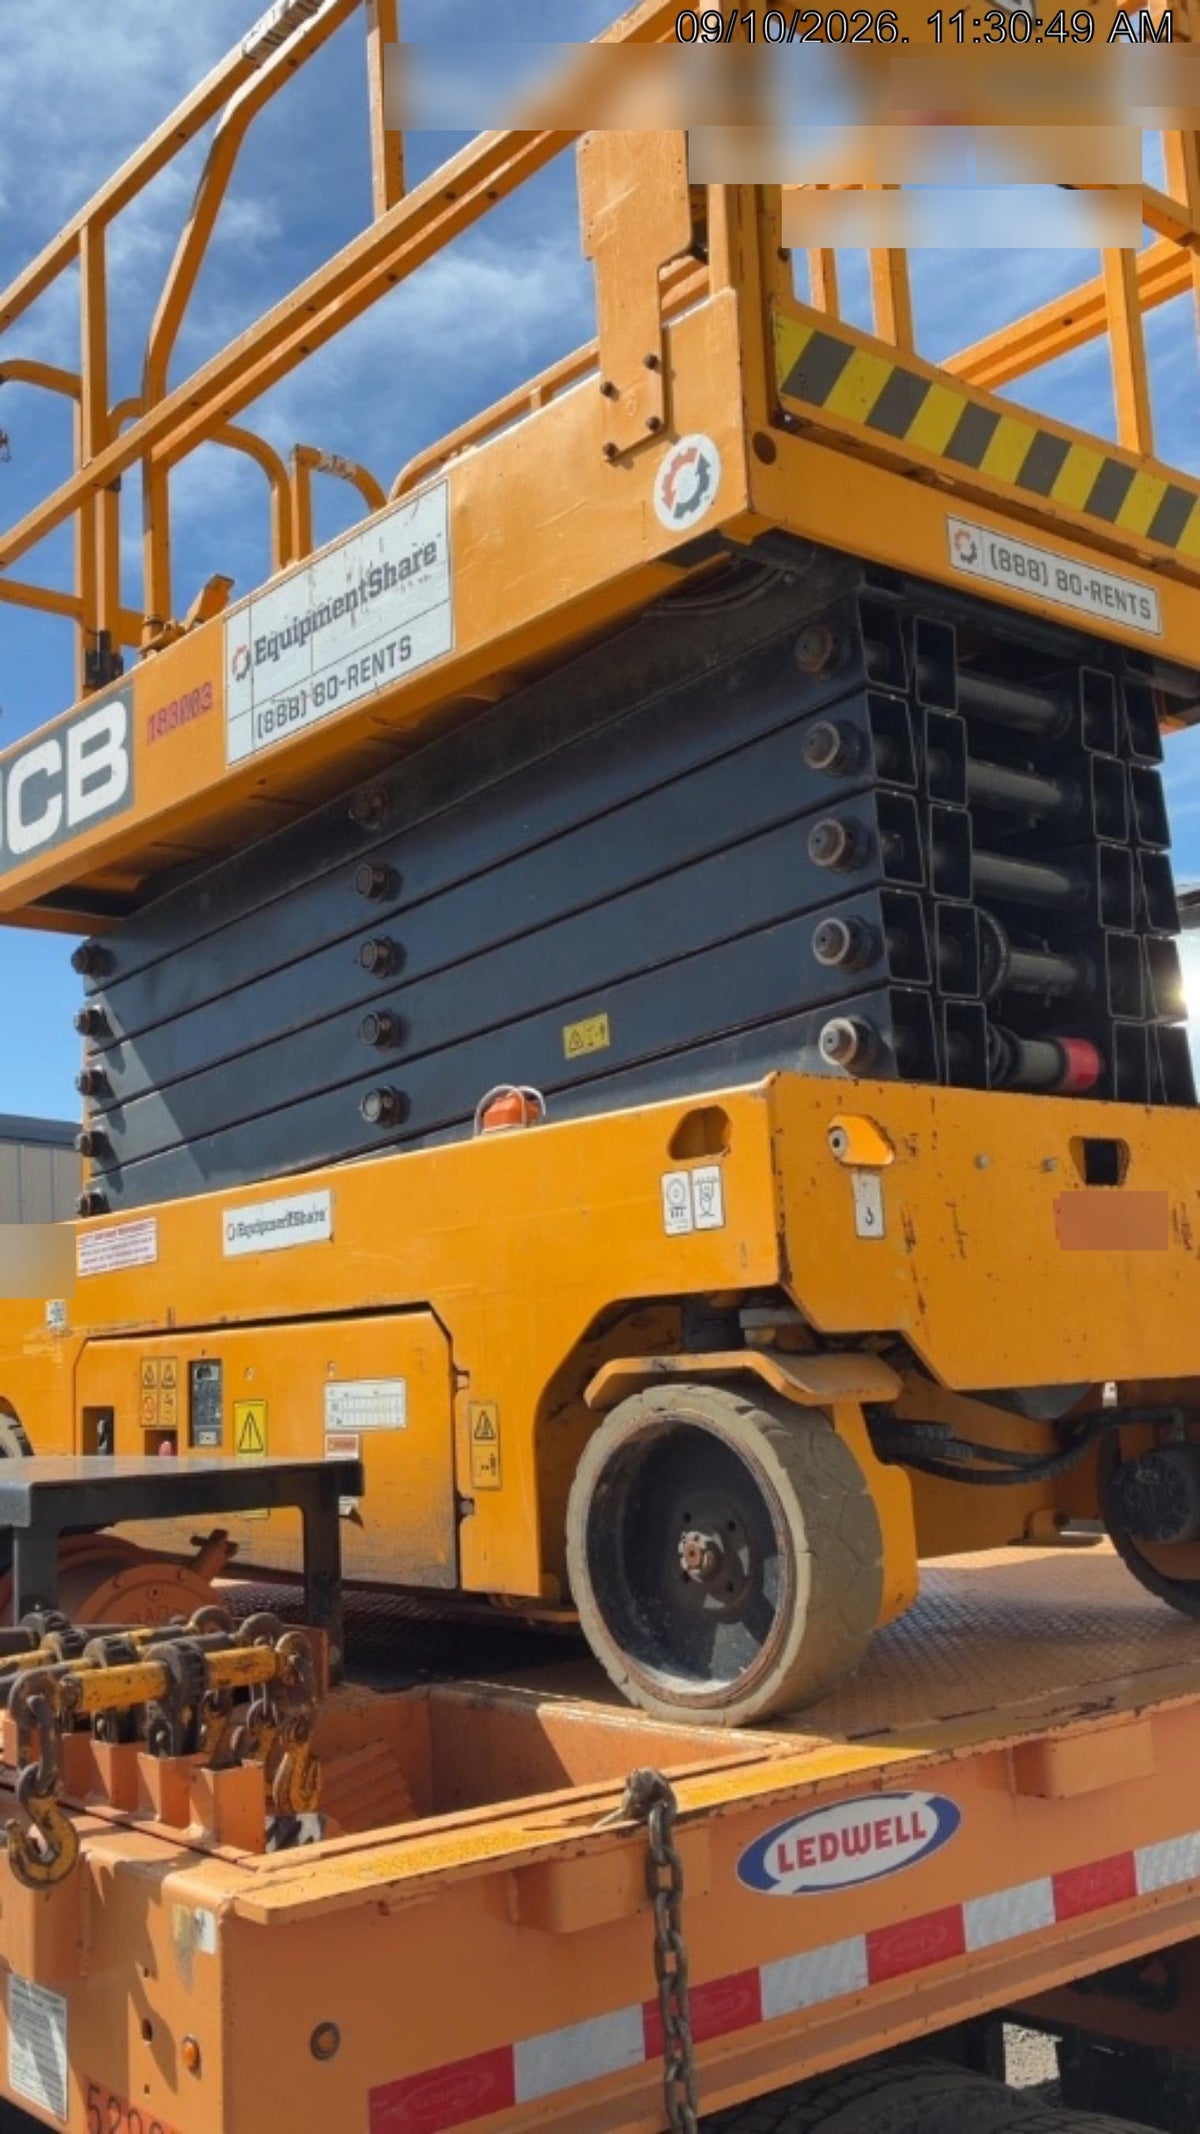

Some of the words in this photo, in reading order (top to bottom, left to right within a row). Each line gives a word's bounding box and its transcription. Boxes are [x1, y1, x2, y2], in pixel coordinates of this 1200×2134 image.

[254, 541, 437, 666] EquipmentShare
[989, 543, 1049, 586] (888)
[1055, 568, 1151, 620] 80-RENTS
[313, 634, 412, 708] 80-RENTS
[0, 701, 129, 854] CB
[777, 1811, 926, 1873] LEDWELL
